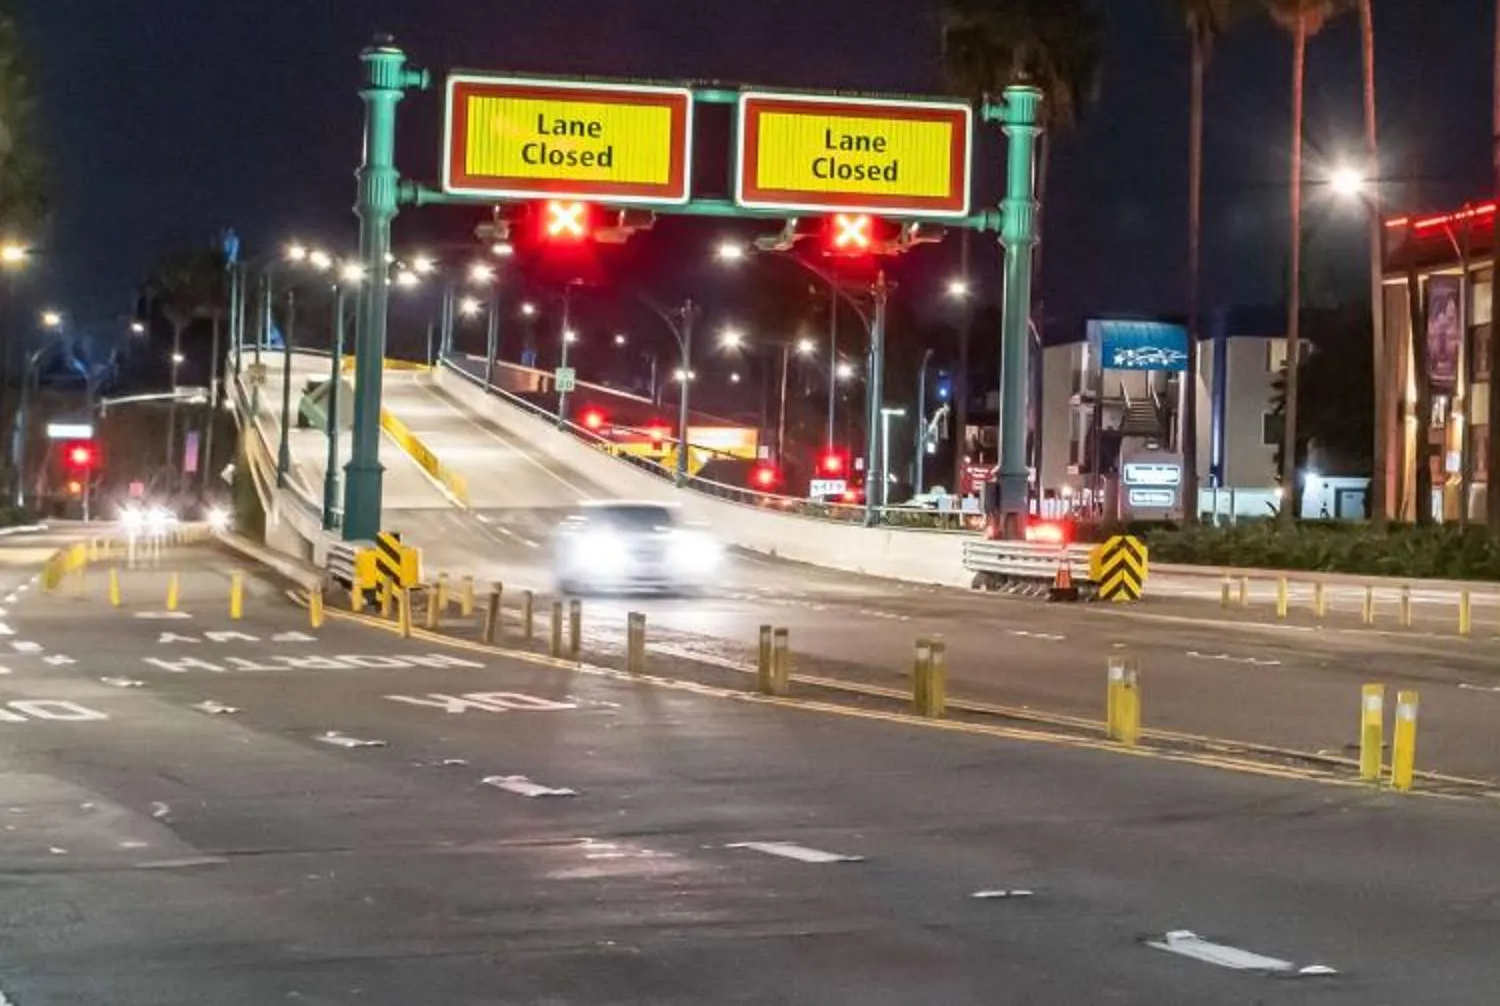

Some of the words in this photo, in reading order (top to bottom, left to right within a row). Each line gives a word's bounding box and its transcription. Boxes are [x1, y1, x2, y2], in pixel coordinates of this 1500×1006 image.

[537, 113, 602, 138] Lane
[825, 129, 887, 153] Lane
[521, 141, 613, 168] Closed
[812, 156, 898, 182] Closed
[142, 653, 487, 673] NORTH
[0, 700, 110, 722] O
